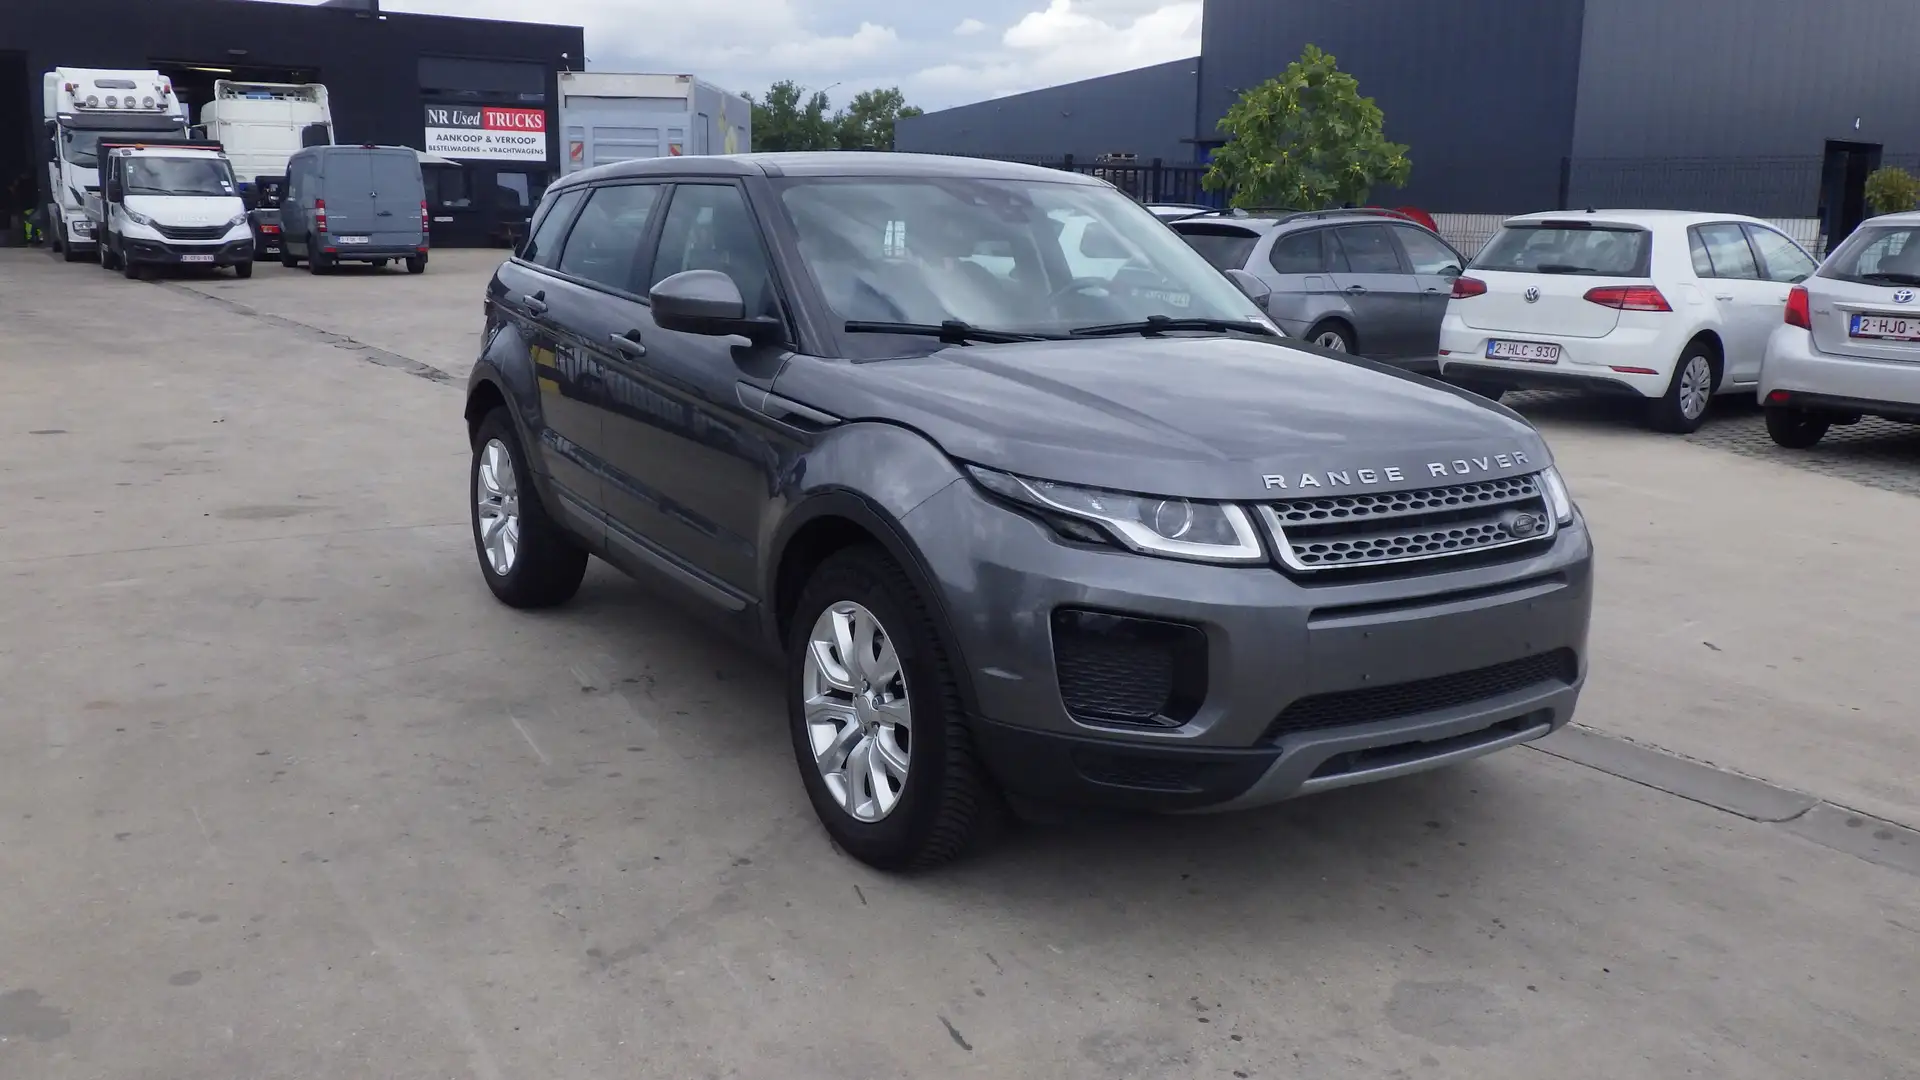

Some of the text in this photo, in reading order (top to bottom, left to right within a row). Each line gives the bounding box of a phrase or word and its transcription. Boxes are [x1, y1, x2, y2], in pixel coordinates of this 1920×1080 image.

[428, 109, 542, 129] NR Used TRUCKS
[436, 134, 483, 143] AANKOOP
[495, 136, 537, 145] VERKOOP
[428, 145, 480, 153] BESTELWAGENS
[488, 147, 544, 155] VRACHTWAGENS
[1262, 451, 1530, 490] RANGE ROVER
